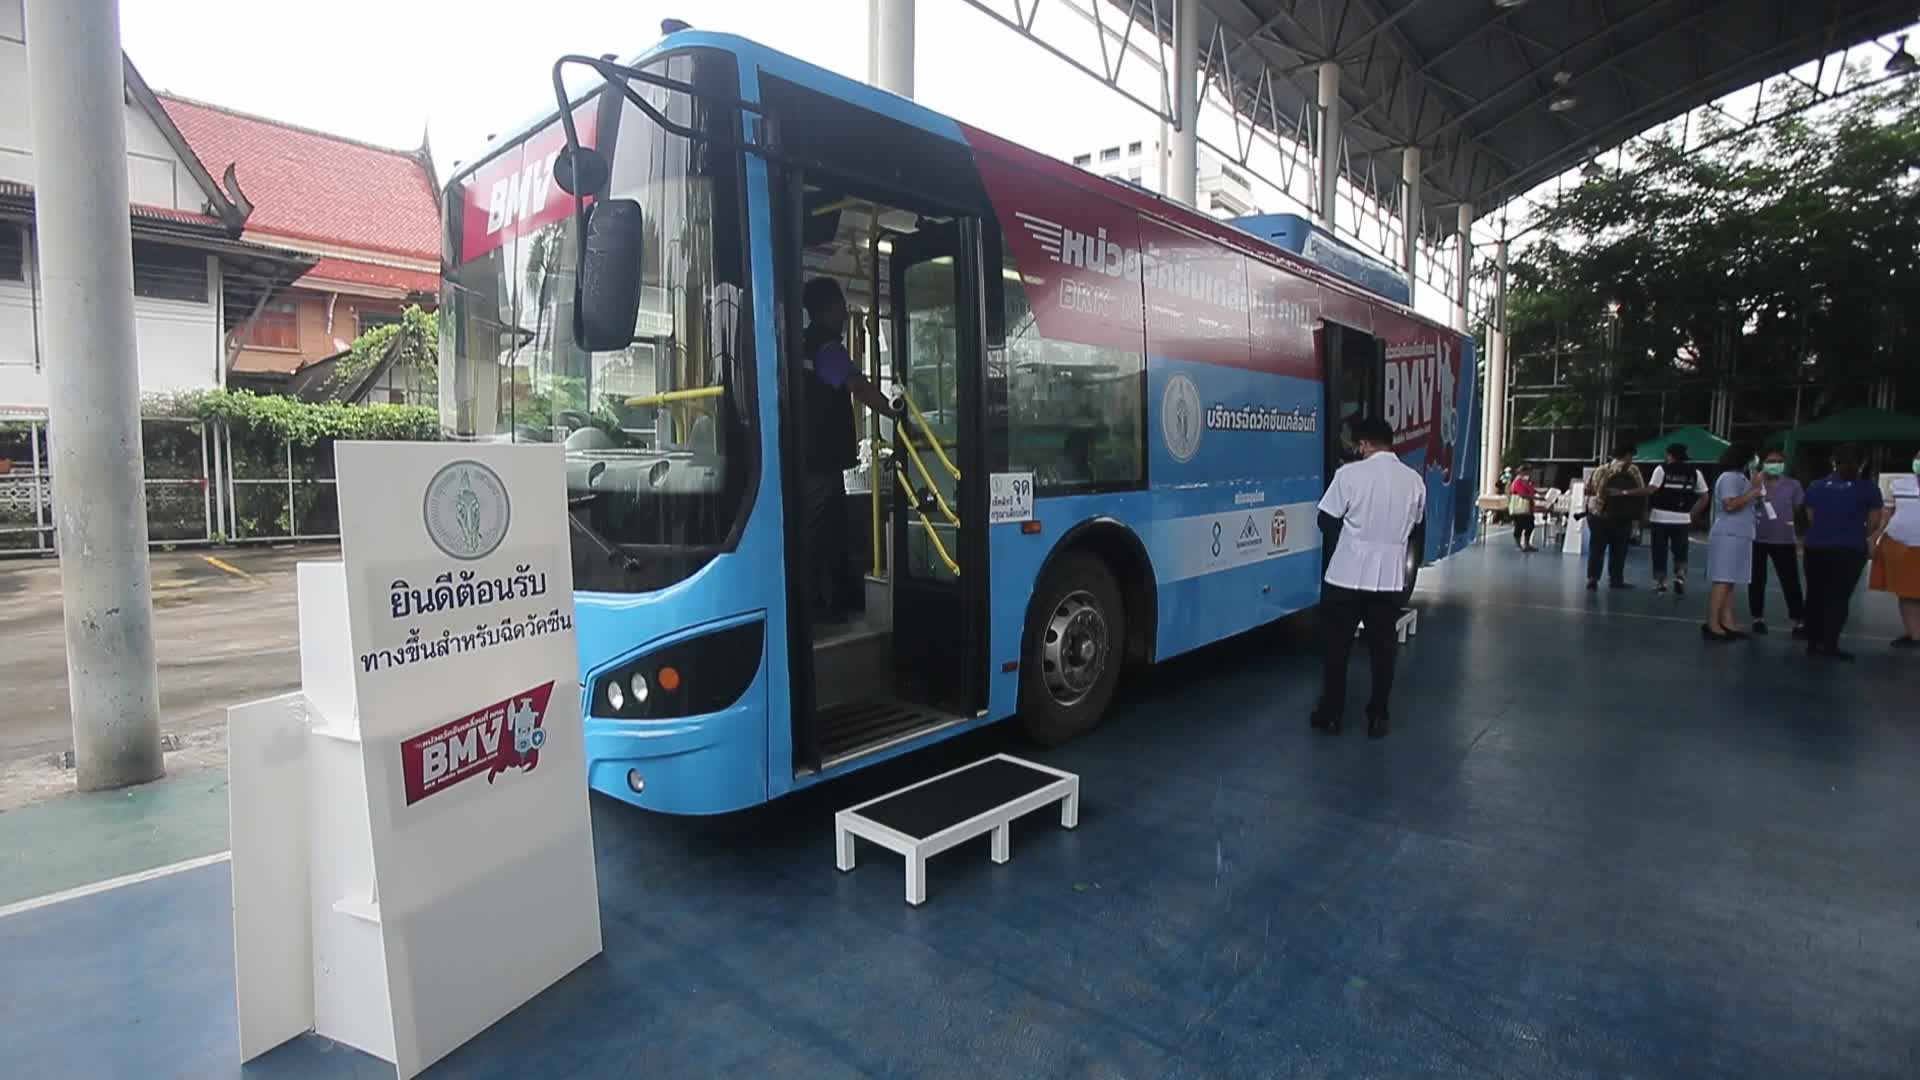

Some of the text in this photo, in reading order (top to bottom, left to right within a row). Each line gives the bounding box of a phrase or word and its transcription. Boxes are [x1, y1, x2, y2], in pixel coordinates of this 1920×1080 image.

[487, 151, 559, 235] BMV
[1384, 357, 1435, 432] BMV
[390, 564, 546, 618] ยินดีต้อนรับ
[361, 608, 572, 673] ทางขึ้นสำหรับฉีดวัคซีน
[422, 716, 503, 784] BMV
